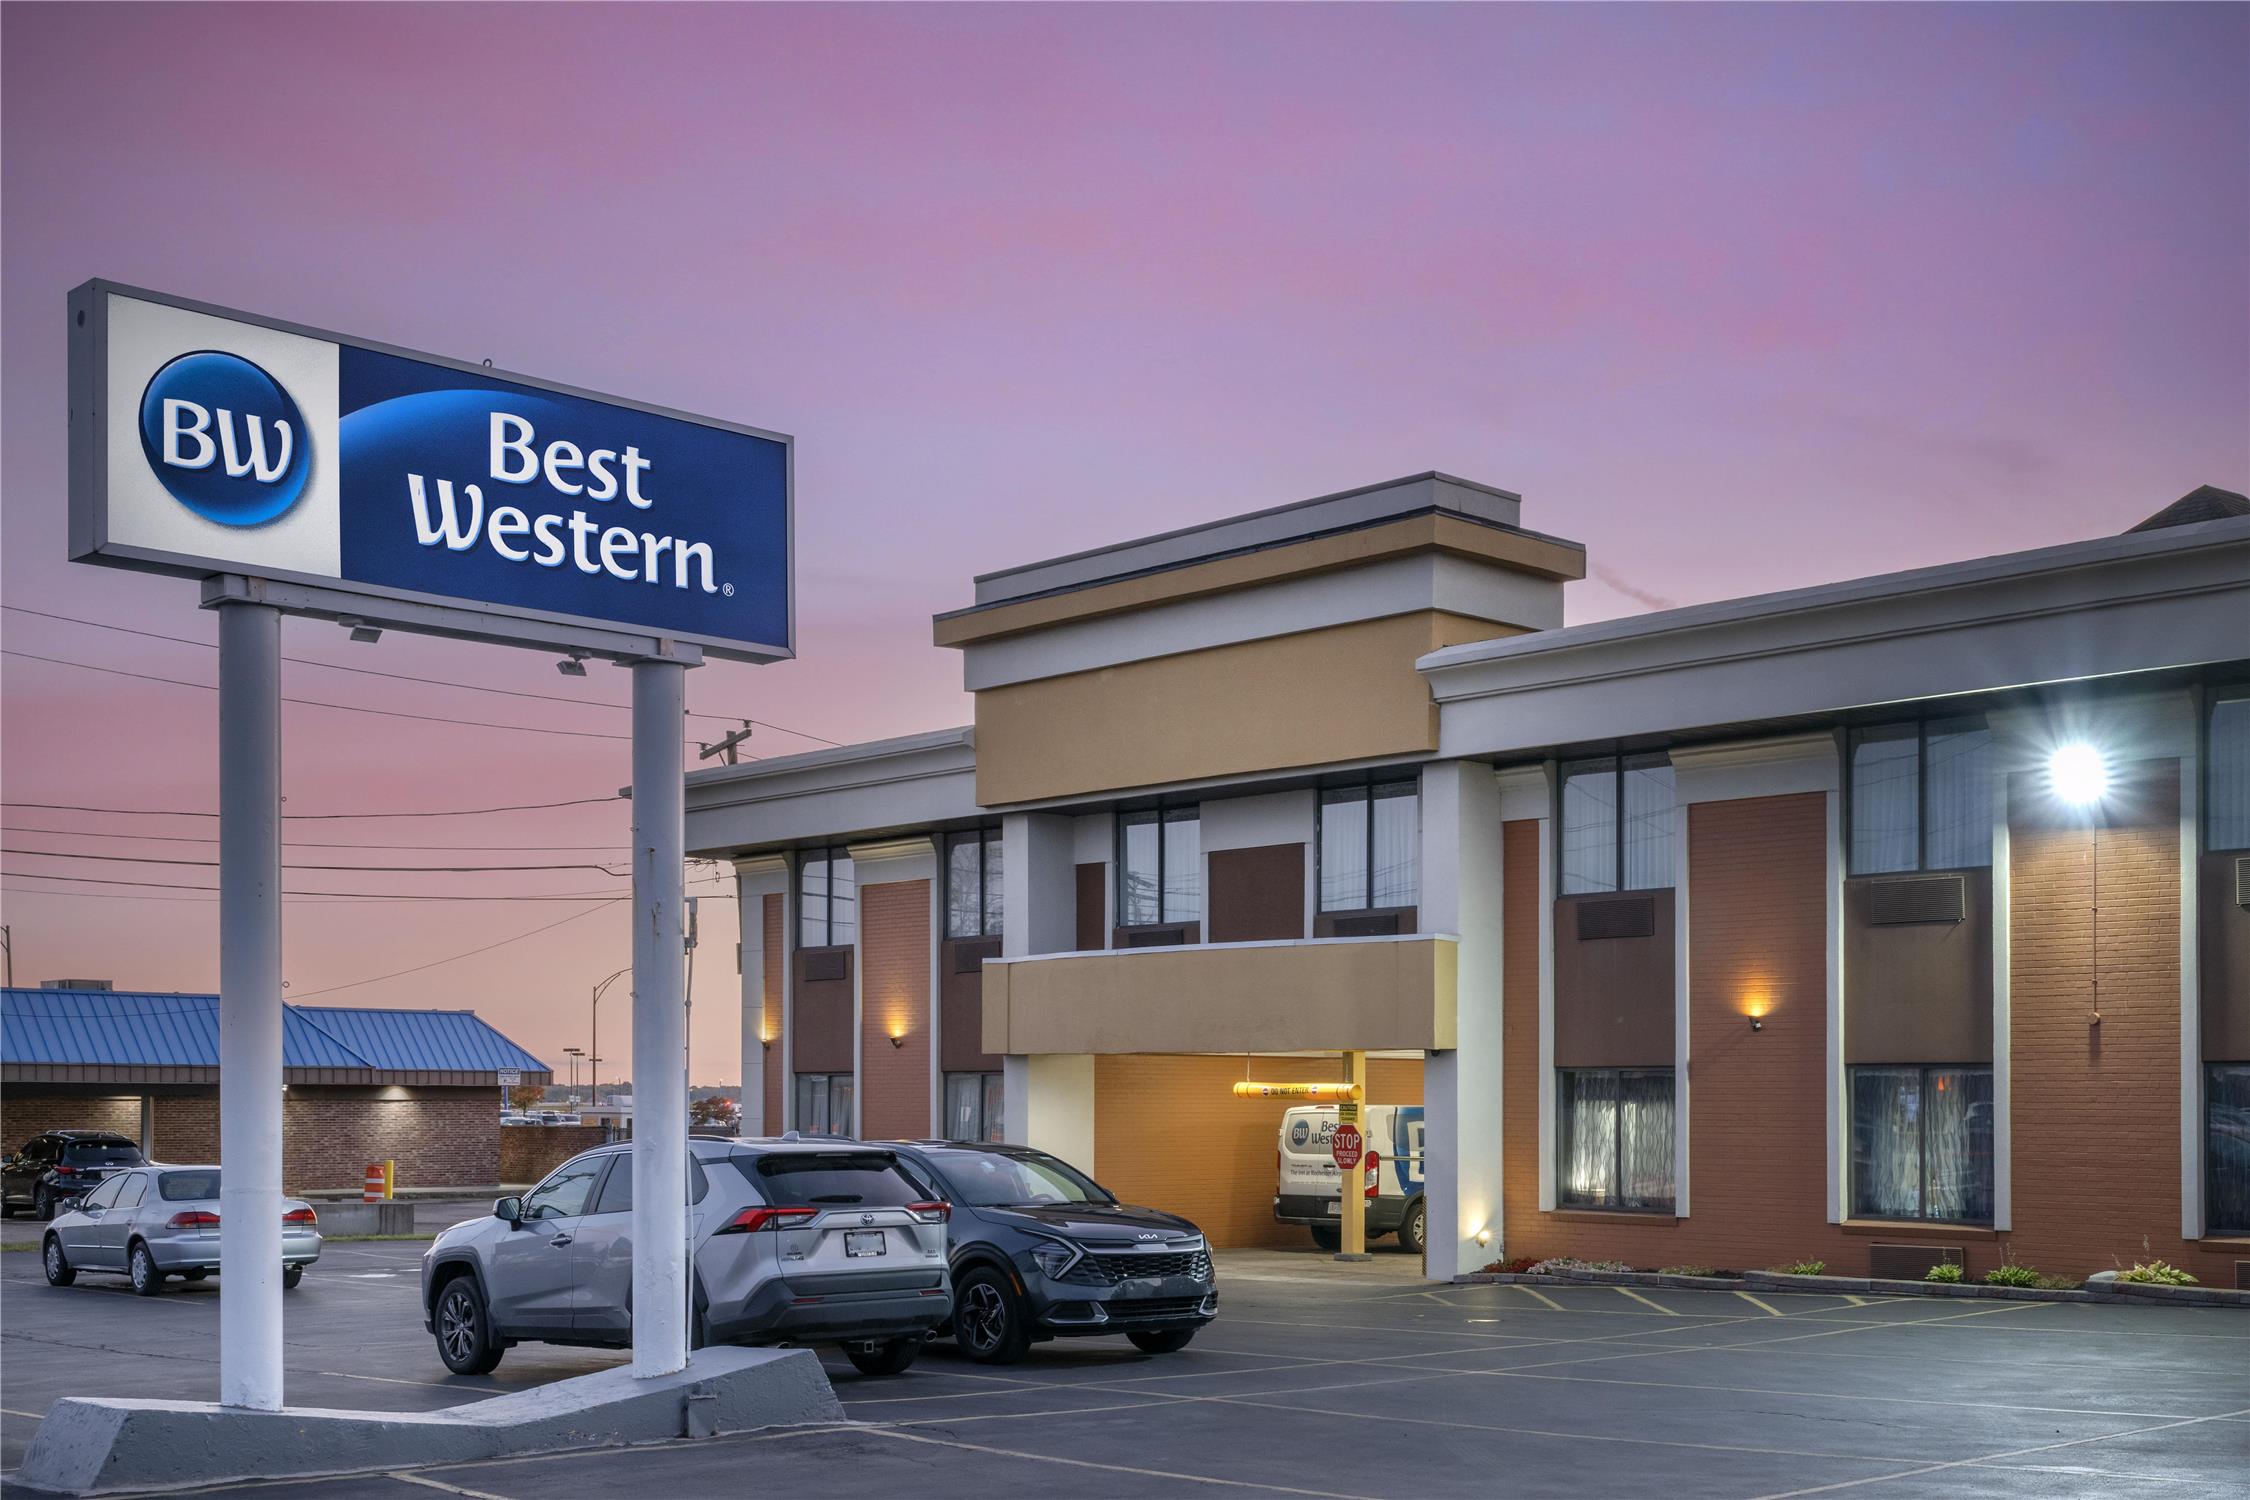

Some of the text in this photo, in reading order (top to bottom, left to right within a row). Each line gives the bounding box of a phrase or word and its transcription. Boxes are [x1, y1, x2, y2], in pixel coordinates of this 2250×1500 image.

[162, 397, 295, 484] BW
[489, 411, 653, 509] Best
[1293, 1128, 1308, 1139] BW
[1322, 1121, 1340, 1132] Bes
[1334, 1134, 1360, 1149] STOP
